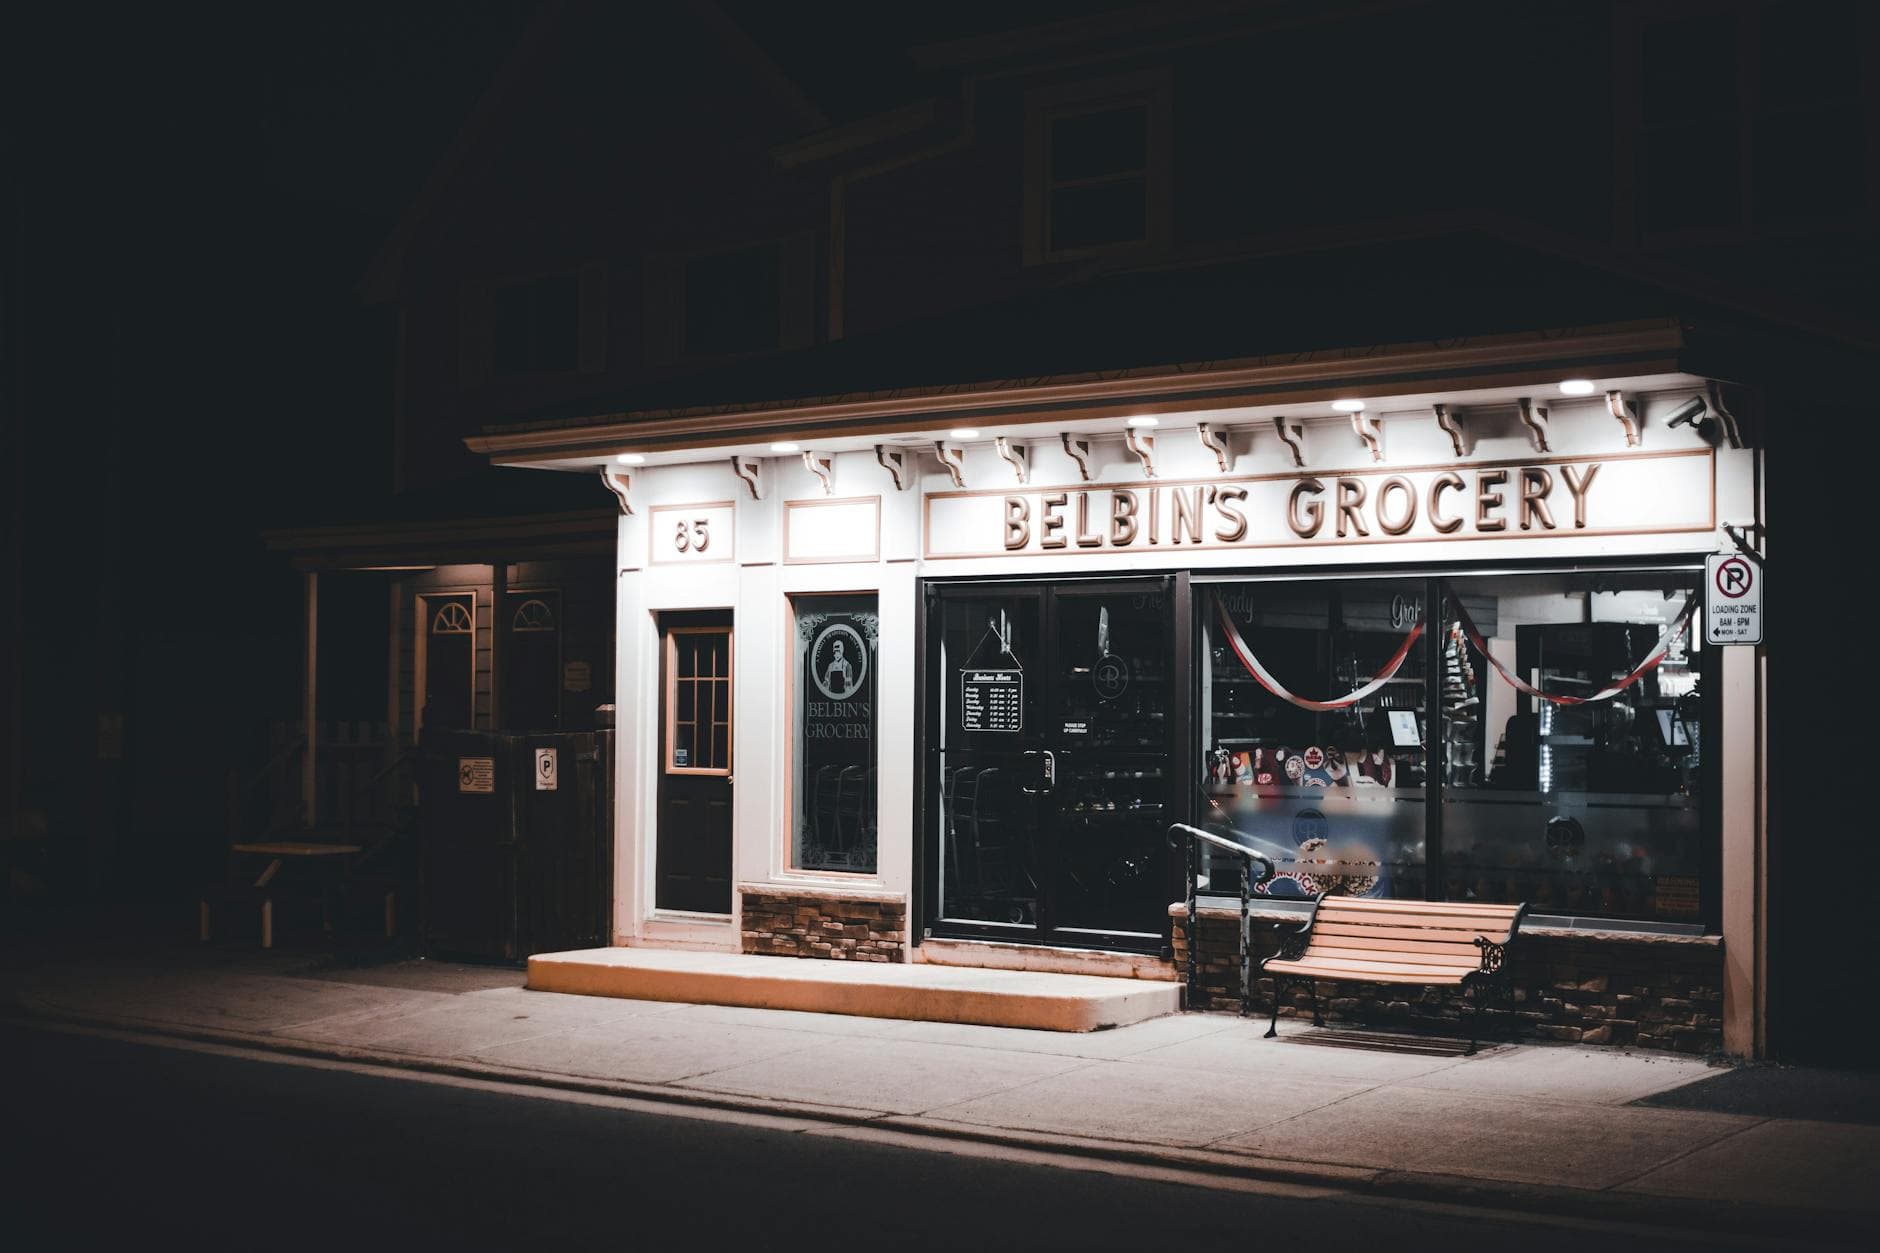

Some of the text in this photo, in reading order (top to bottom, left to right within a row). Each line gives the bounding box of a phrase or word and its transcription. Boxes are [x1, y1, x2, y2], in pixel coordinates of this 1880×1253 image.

[1003, 463, 1602, 551] BELBIN'S GROCERY
[674, 518, 710, 553] 85
[1712, 604, 1757, 614] LOADING ZONE
[808, 702, 870, 718] BELBIN'S
[805, 723, 870, 739] GROCERY
[543, 760, 551, 772] P
